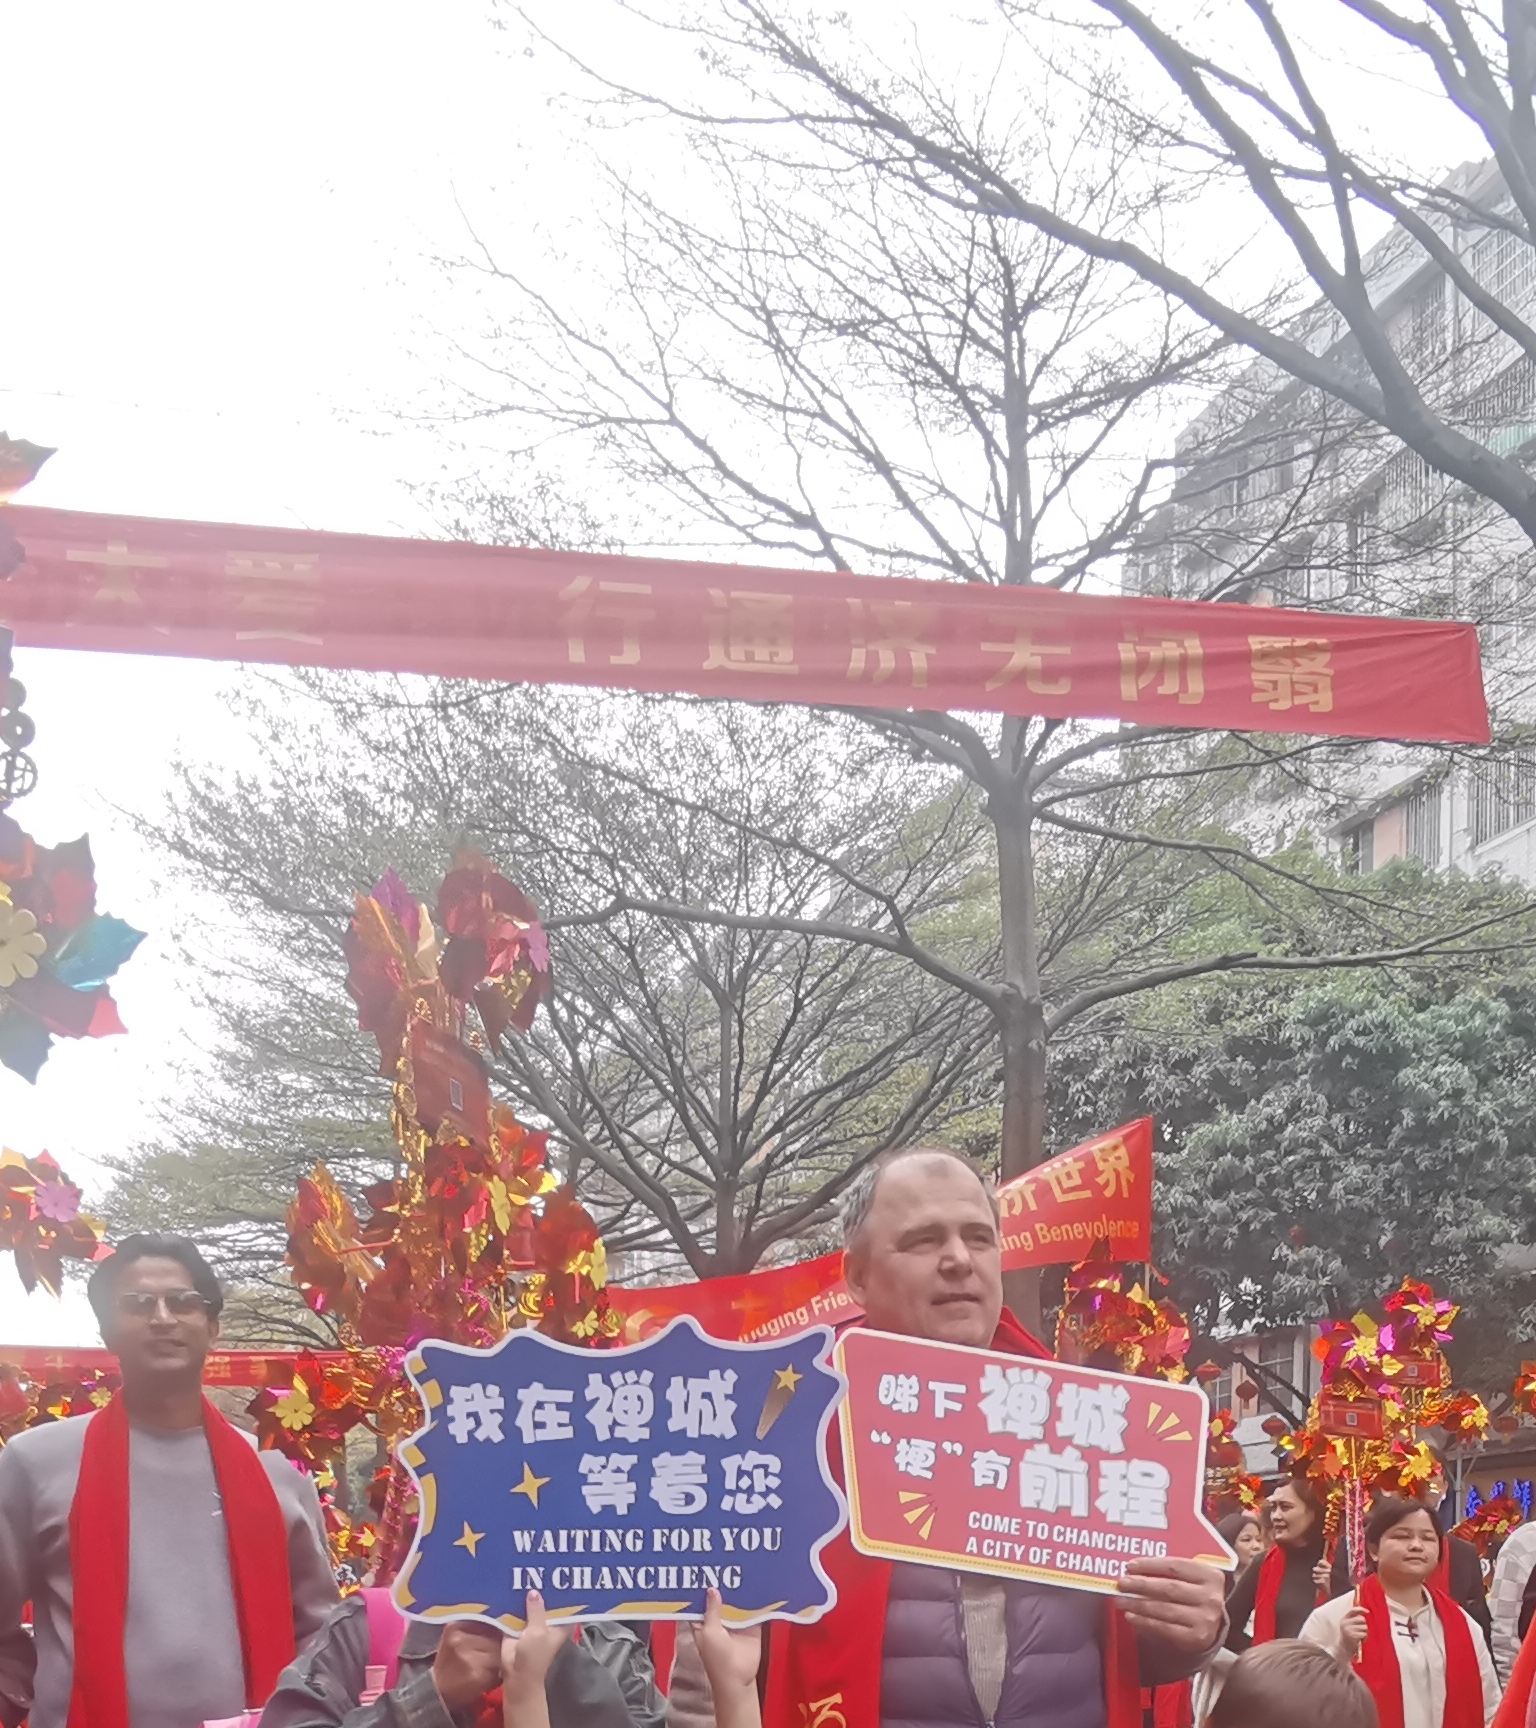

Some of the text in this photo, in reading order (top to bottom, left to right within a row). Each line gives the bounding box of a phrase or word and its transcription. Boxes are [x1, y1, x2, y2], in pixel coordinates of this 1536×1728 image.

[1000, 1213, 1140, 1252] ing Benevolence
[811, 1291, 854, 1317] Frie
[446, 1368, 739, 1444] 我在禅城
[878, 1364, 1131, 1454] 睇下禅城
[578, 1450, 783, 1515] 等着您
[513, 1527, 783, 1554] WAITING FOR YOU
[965, 1536, 979, 1554] A
[982, 1539, 1025, 1561] CITY
[1028, 1547, 1053, 1566] OF
[968, 1511, 1168, 1558] COME TO CHANCHENG
[512, 1566, 743, 1590] IN CHANCHENG
